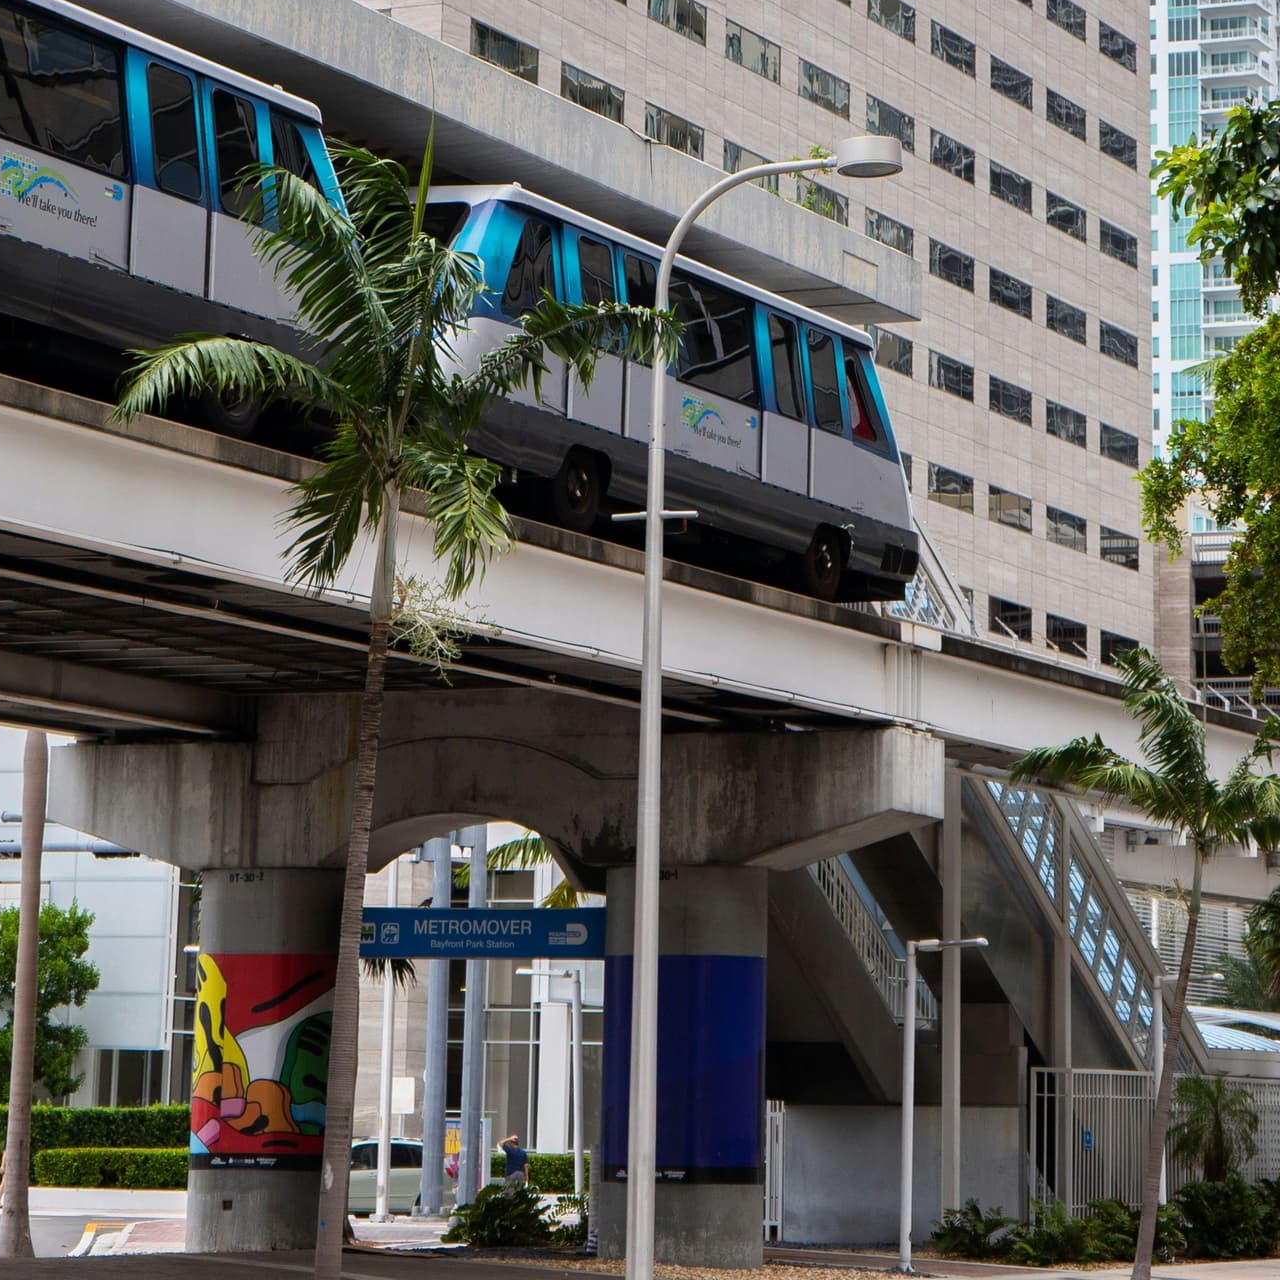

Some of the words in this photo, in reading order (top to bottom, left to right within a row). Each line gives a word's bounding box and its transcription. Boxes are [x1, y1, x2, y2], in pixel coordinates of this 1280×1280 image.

[17, 190, 39, 209] We'll
[39, 198, 57, 215] take
[57, 206, 73, 221] you
[73, 208, 98, 228] there!
[413, 919, 533, 936] METROMOVER
[430, 939, 464, 950] Bayfront
[465, 939, 484, 949] Park
[486, 939, 515, 949] Station
